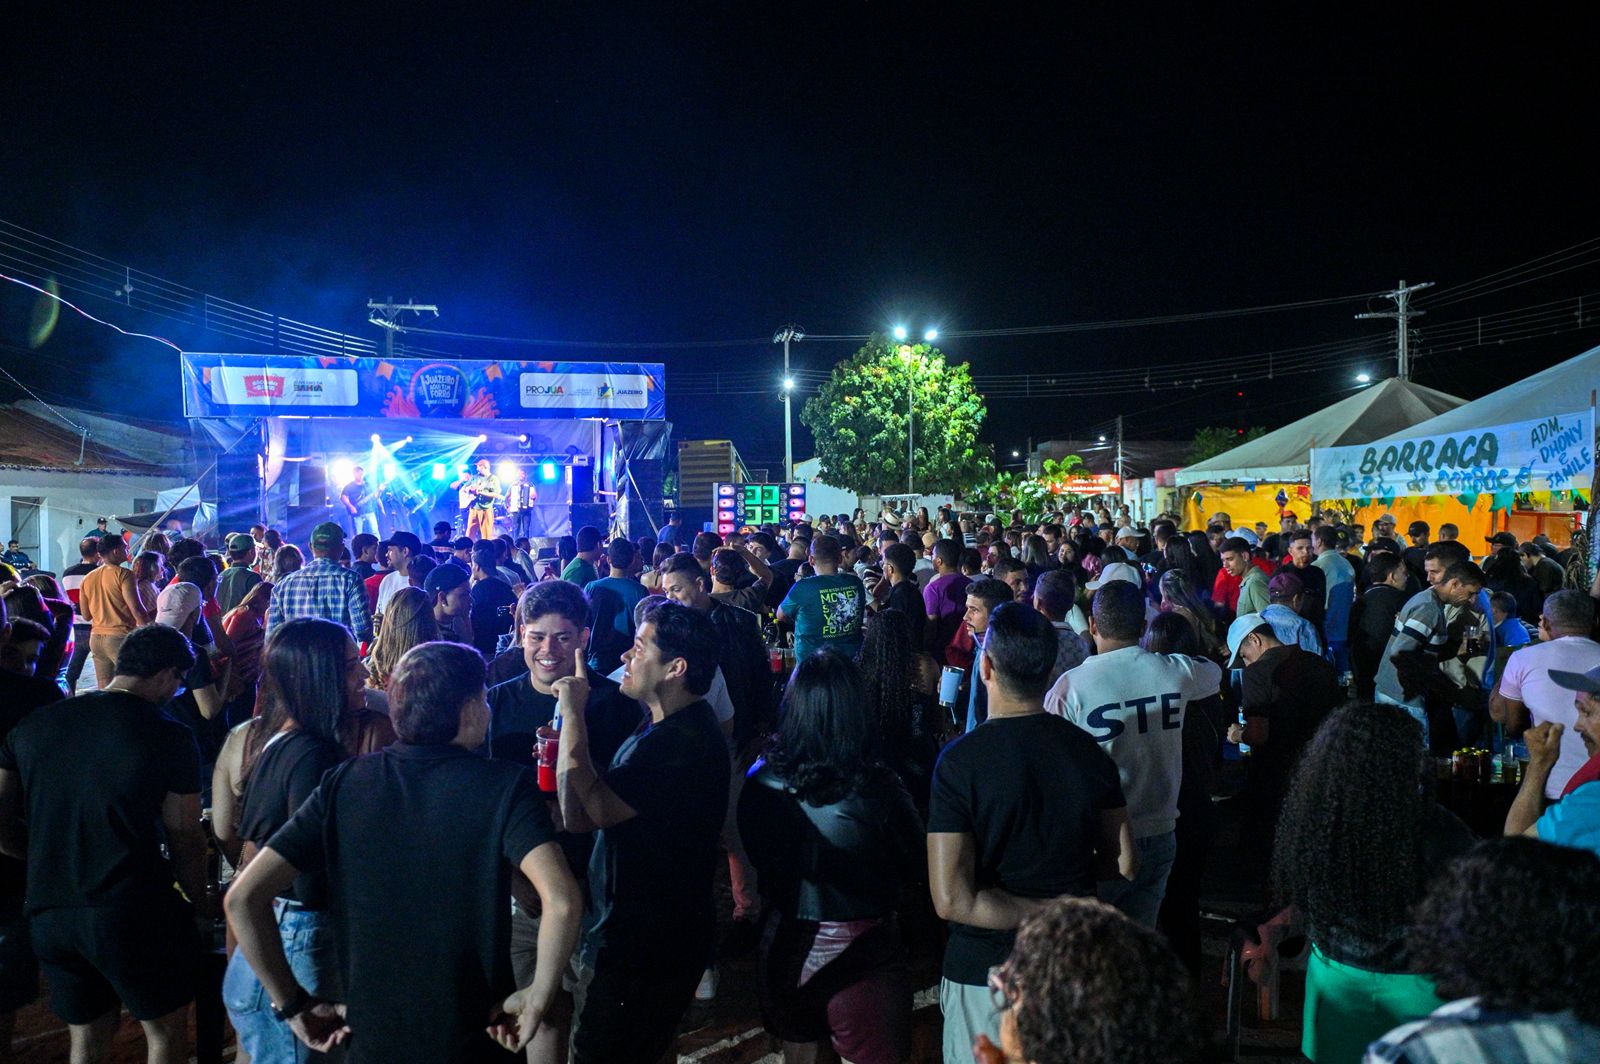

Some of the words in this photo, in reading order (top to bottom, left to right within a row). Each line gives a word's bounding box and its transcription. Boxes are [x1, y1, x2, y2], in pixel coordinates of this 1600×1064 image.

[526, 385, 564, 394] PROJUA
[1531, 416, 1563, 448] ADM.
[1540, 420, 1582, 463] DHONY
[1359, 432, 1499, 475] BARRACA
[1546, 446, 1592, 488] JAMILE
[1086, 693, 1182, 743] STE
